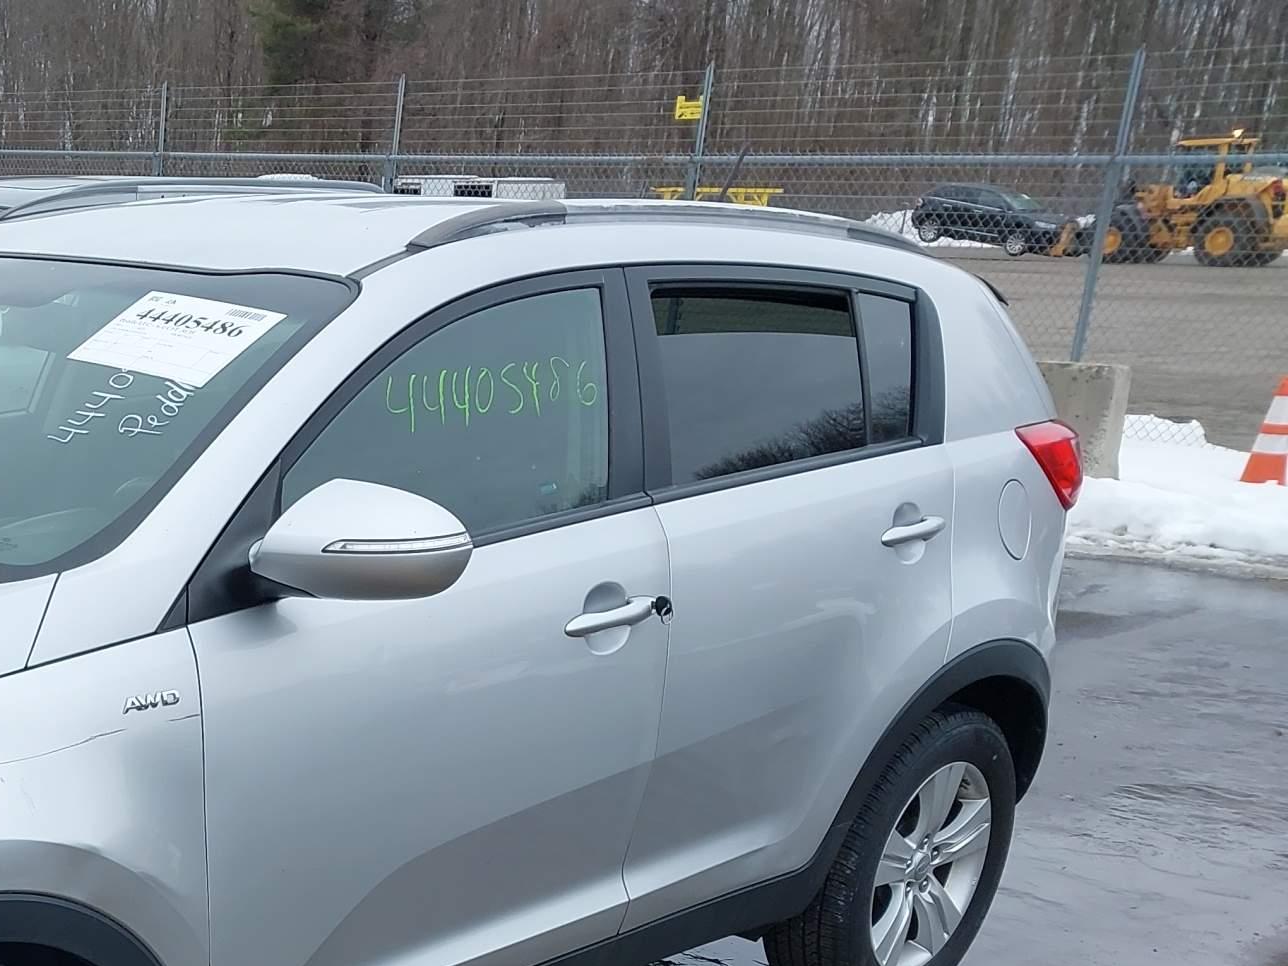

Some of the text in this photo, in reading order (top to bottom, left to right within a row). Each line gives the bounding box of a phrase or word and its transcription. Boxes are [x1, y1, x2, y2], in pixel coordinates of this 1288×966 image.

[136, 308, 248, 338] 44405486
[47, 367, 134, 443] 4440
[386, 356, 599, 433] 44405486
[122, 689, 181, 714] AWD
